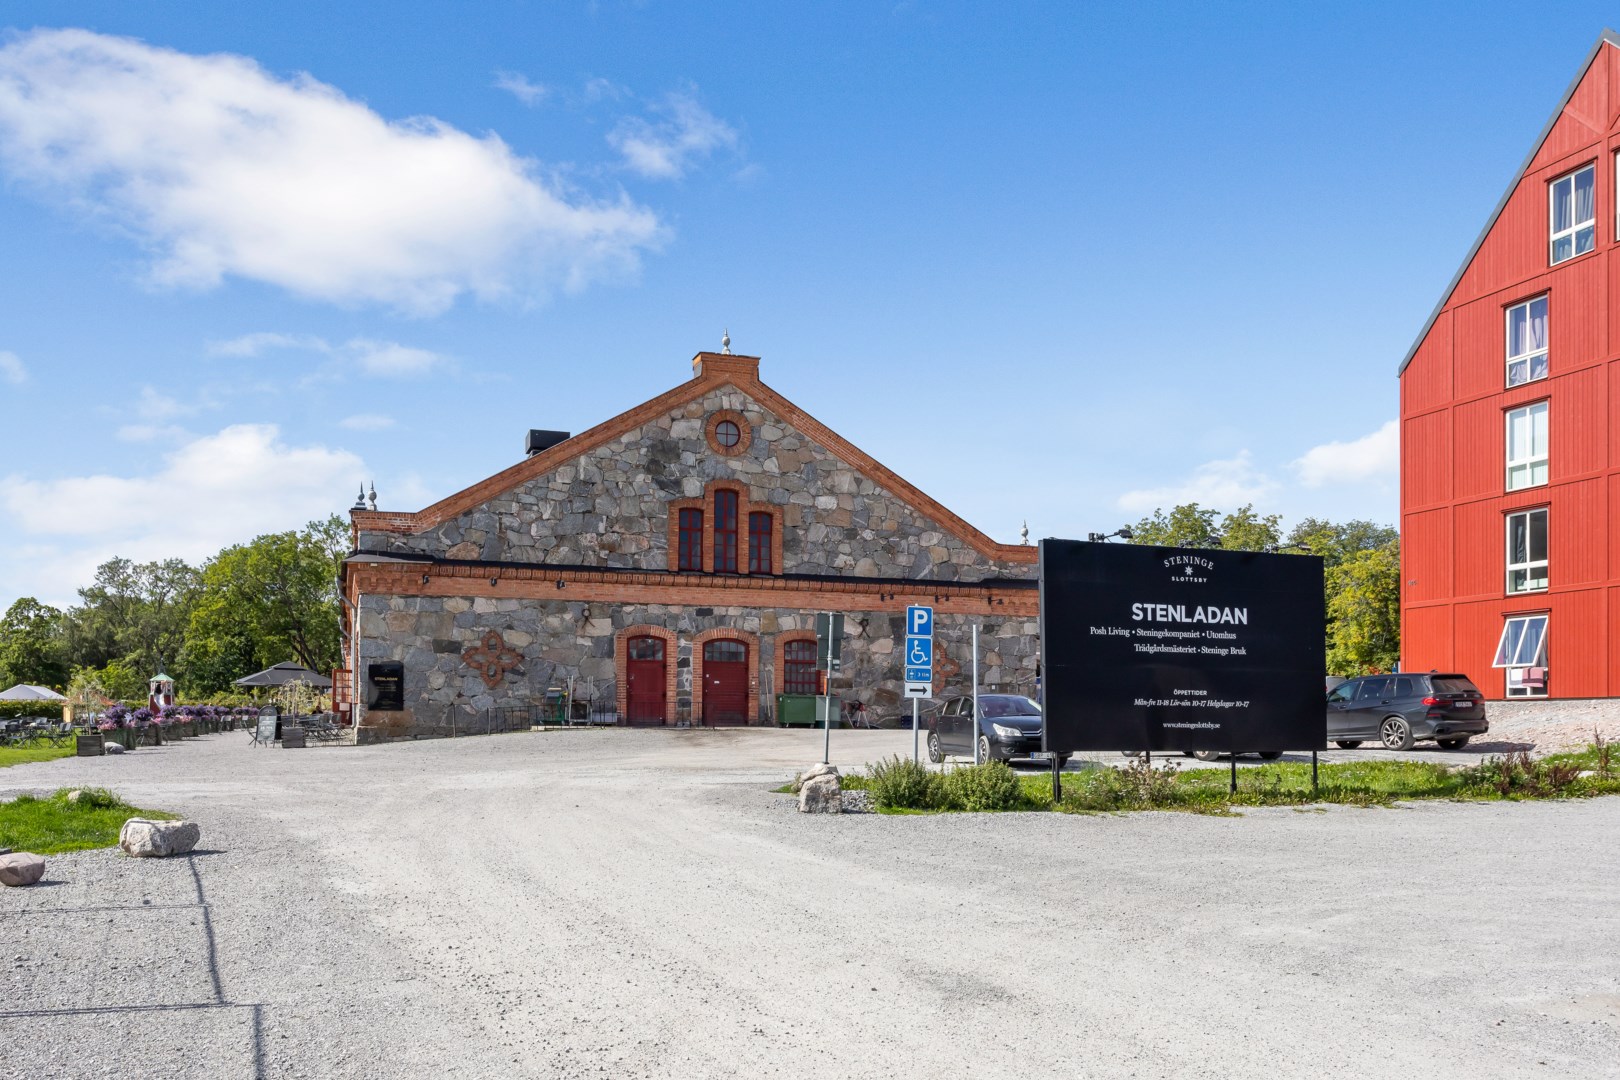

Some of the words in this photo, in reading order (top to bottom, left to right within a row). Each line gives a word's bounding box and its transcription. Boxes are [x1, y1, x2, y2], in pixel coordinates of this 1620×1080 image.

[1163, 555, 1215, 570] STENINGE
[1132, 602, 1248, 625] STENLADAN
[914, 610, 928, 633] P
[1090, 626, 1107, 635] Posh
[1108, 626, 1130, 638] Living
[1136, 628, 1200, 639] Steningekompaniet
[1206, 631, 1237, 639] Utomhus
[1134, 643, 1197, 654] Trädgårdsmästeriet
[1201, 646, 1229, 656] Steninge
[1230, 646, 1247, 656] Bruk
[1173, 688, 1208, 696] ÖPPETTIDER
[1192, 700, 1207, 708] 10-17
[1207, 699, 1235, 709] Helgdagar
